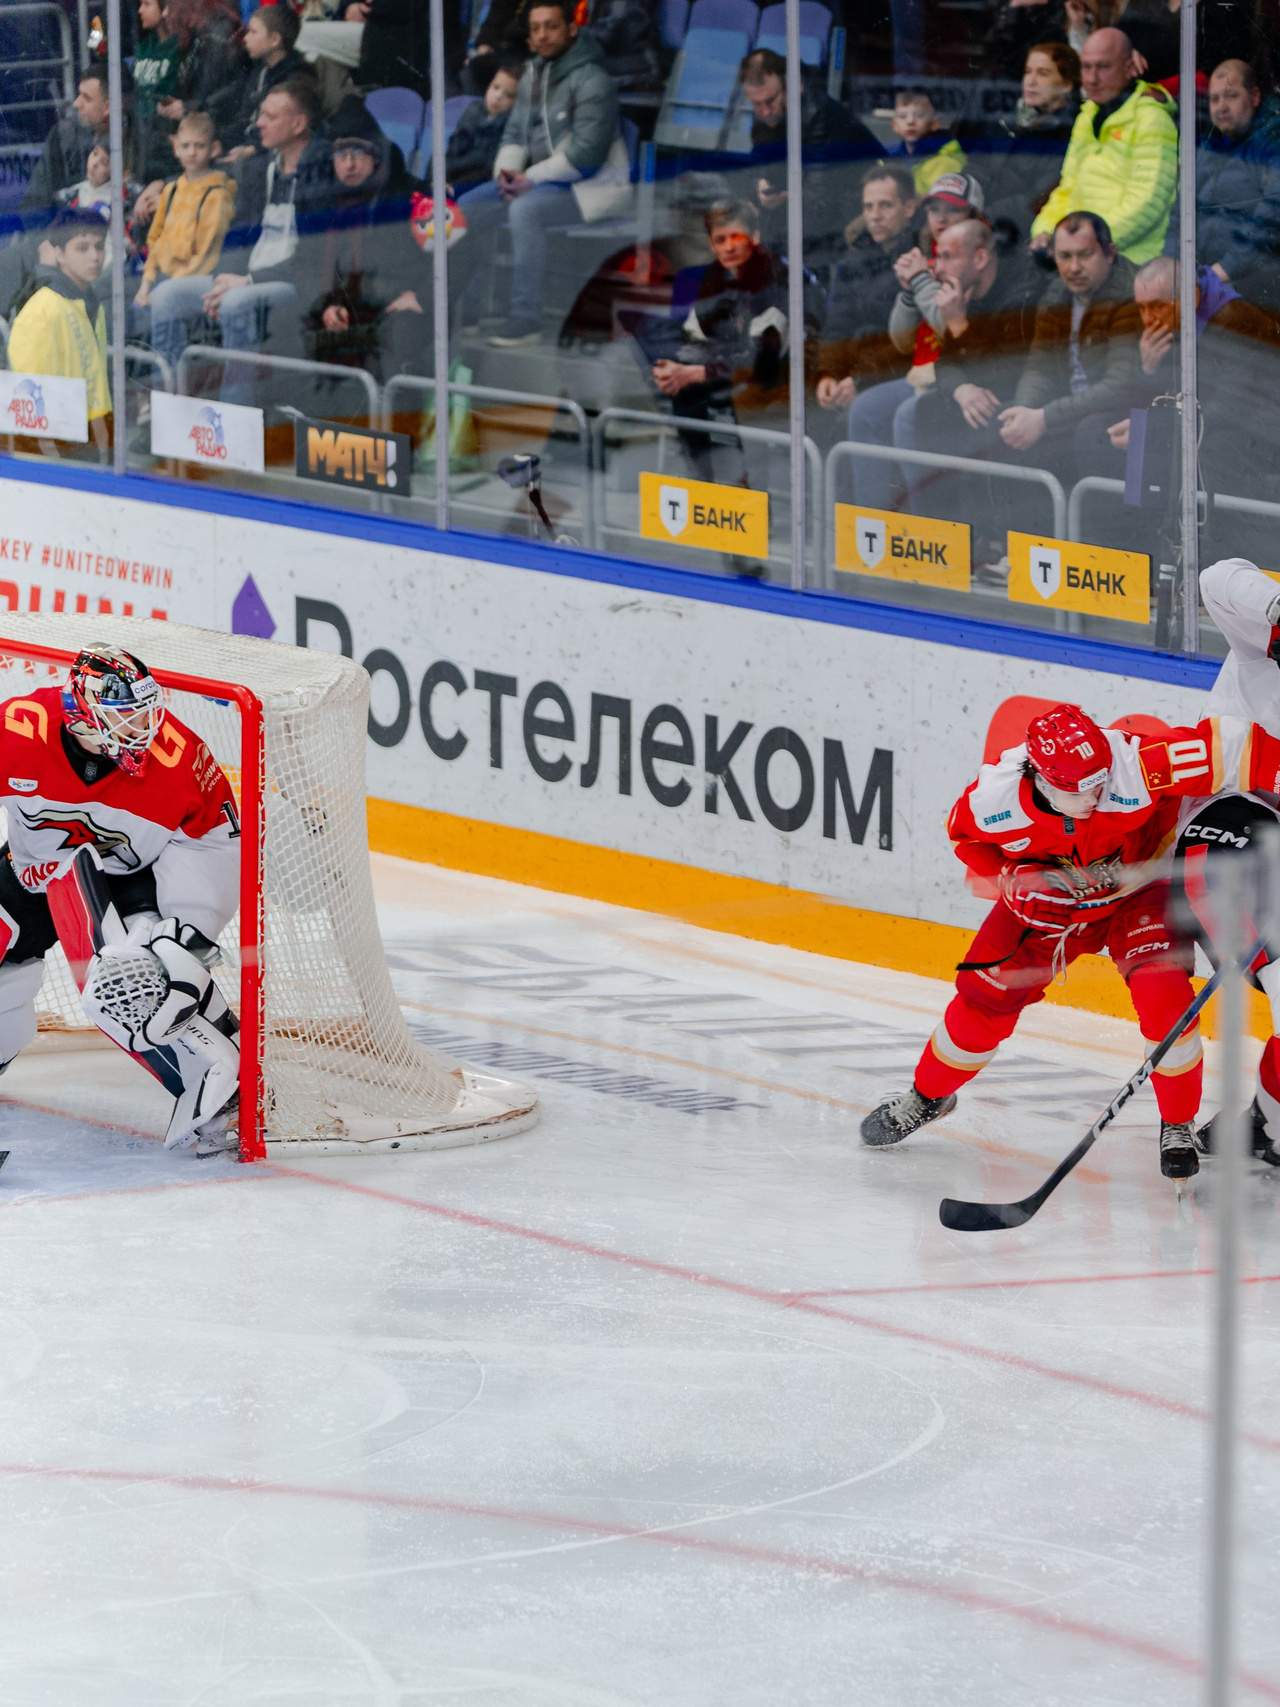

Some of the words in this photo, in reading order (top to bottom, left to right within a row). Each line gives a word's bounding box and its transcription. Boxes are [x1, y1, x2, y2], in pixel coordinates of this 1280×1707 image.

[7, 398, 35, 415] АВТО
[15, 413, 48, 431] РАДИО
[188, 425, 214, 443] АВТО
[195, 441, 228, 460] РАДИО
[307, 426, 397, 488] МАТЧ!
[693, 504, 747, 534] БАНК
[891, 535, 949, 567] БАНК
[41, 544, 173, 589] #UNITEDWEWIN
[1066, 566, 1126, 597] БАНК
[1075, 741, 1095, 760] 10
[1168, 739, 1209, 783] 10
[1109, 792, 1140, 806] SIBUR
[983, 810, 1012, 826] SIBUR
[1184, 824, 1249, 849] CCM
[1125, 942, 1170, 960] CCM
[1092, 1058, 1155, 1140] CCM
